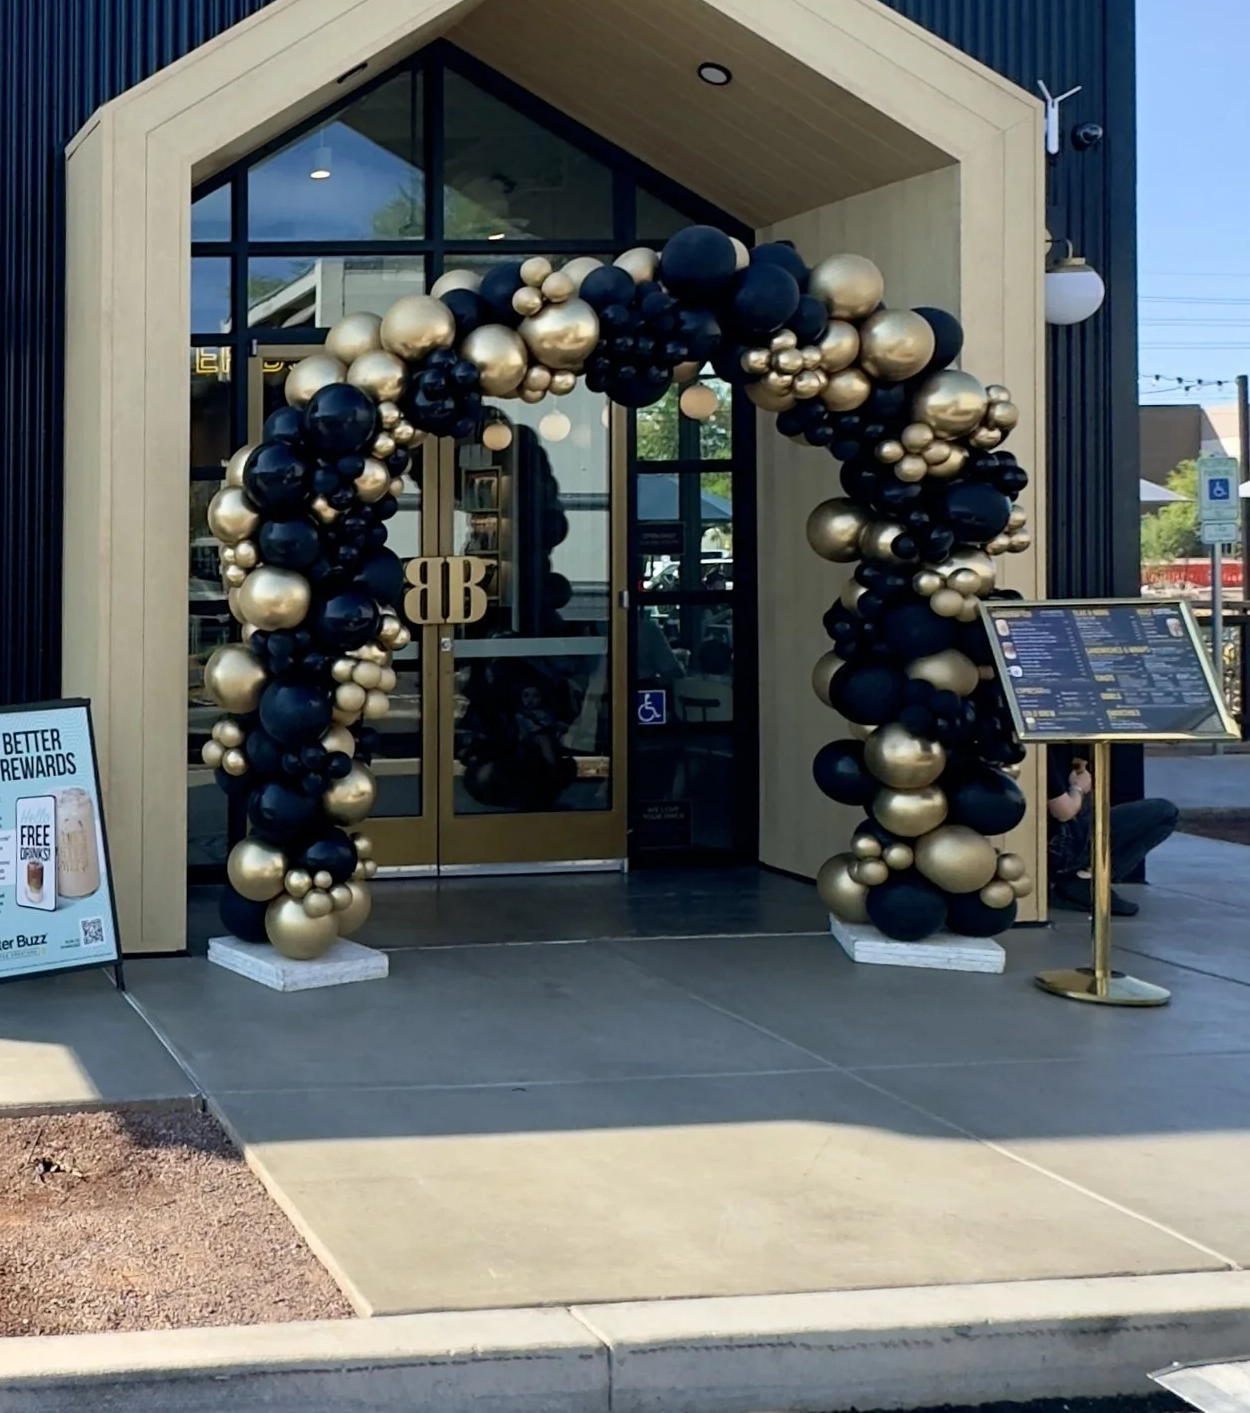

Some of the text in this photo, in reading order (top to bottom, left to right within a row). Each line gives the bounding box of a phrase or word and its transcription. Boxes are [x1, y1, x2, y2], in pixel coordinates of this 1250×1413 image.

[2, 728, 62, 756] BETTER
[0, 752, 77, 782] REWARDS
[20, 824, 50, 847] FREE
[20, 847, 50, 861] DRINKS!
[16, 933, 48, 948] Buzz
